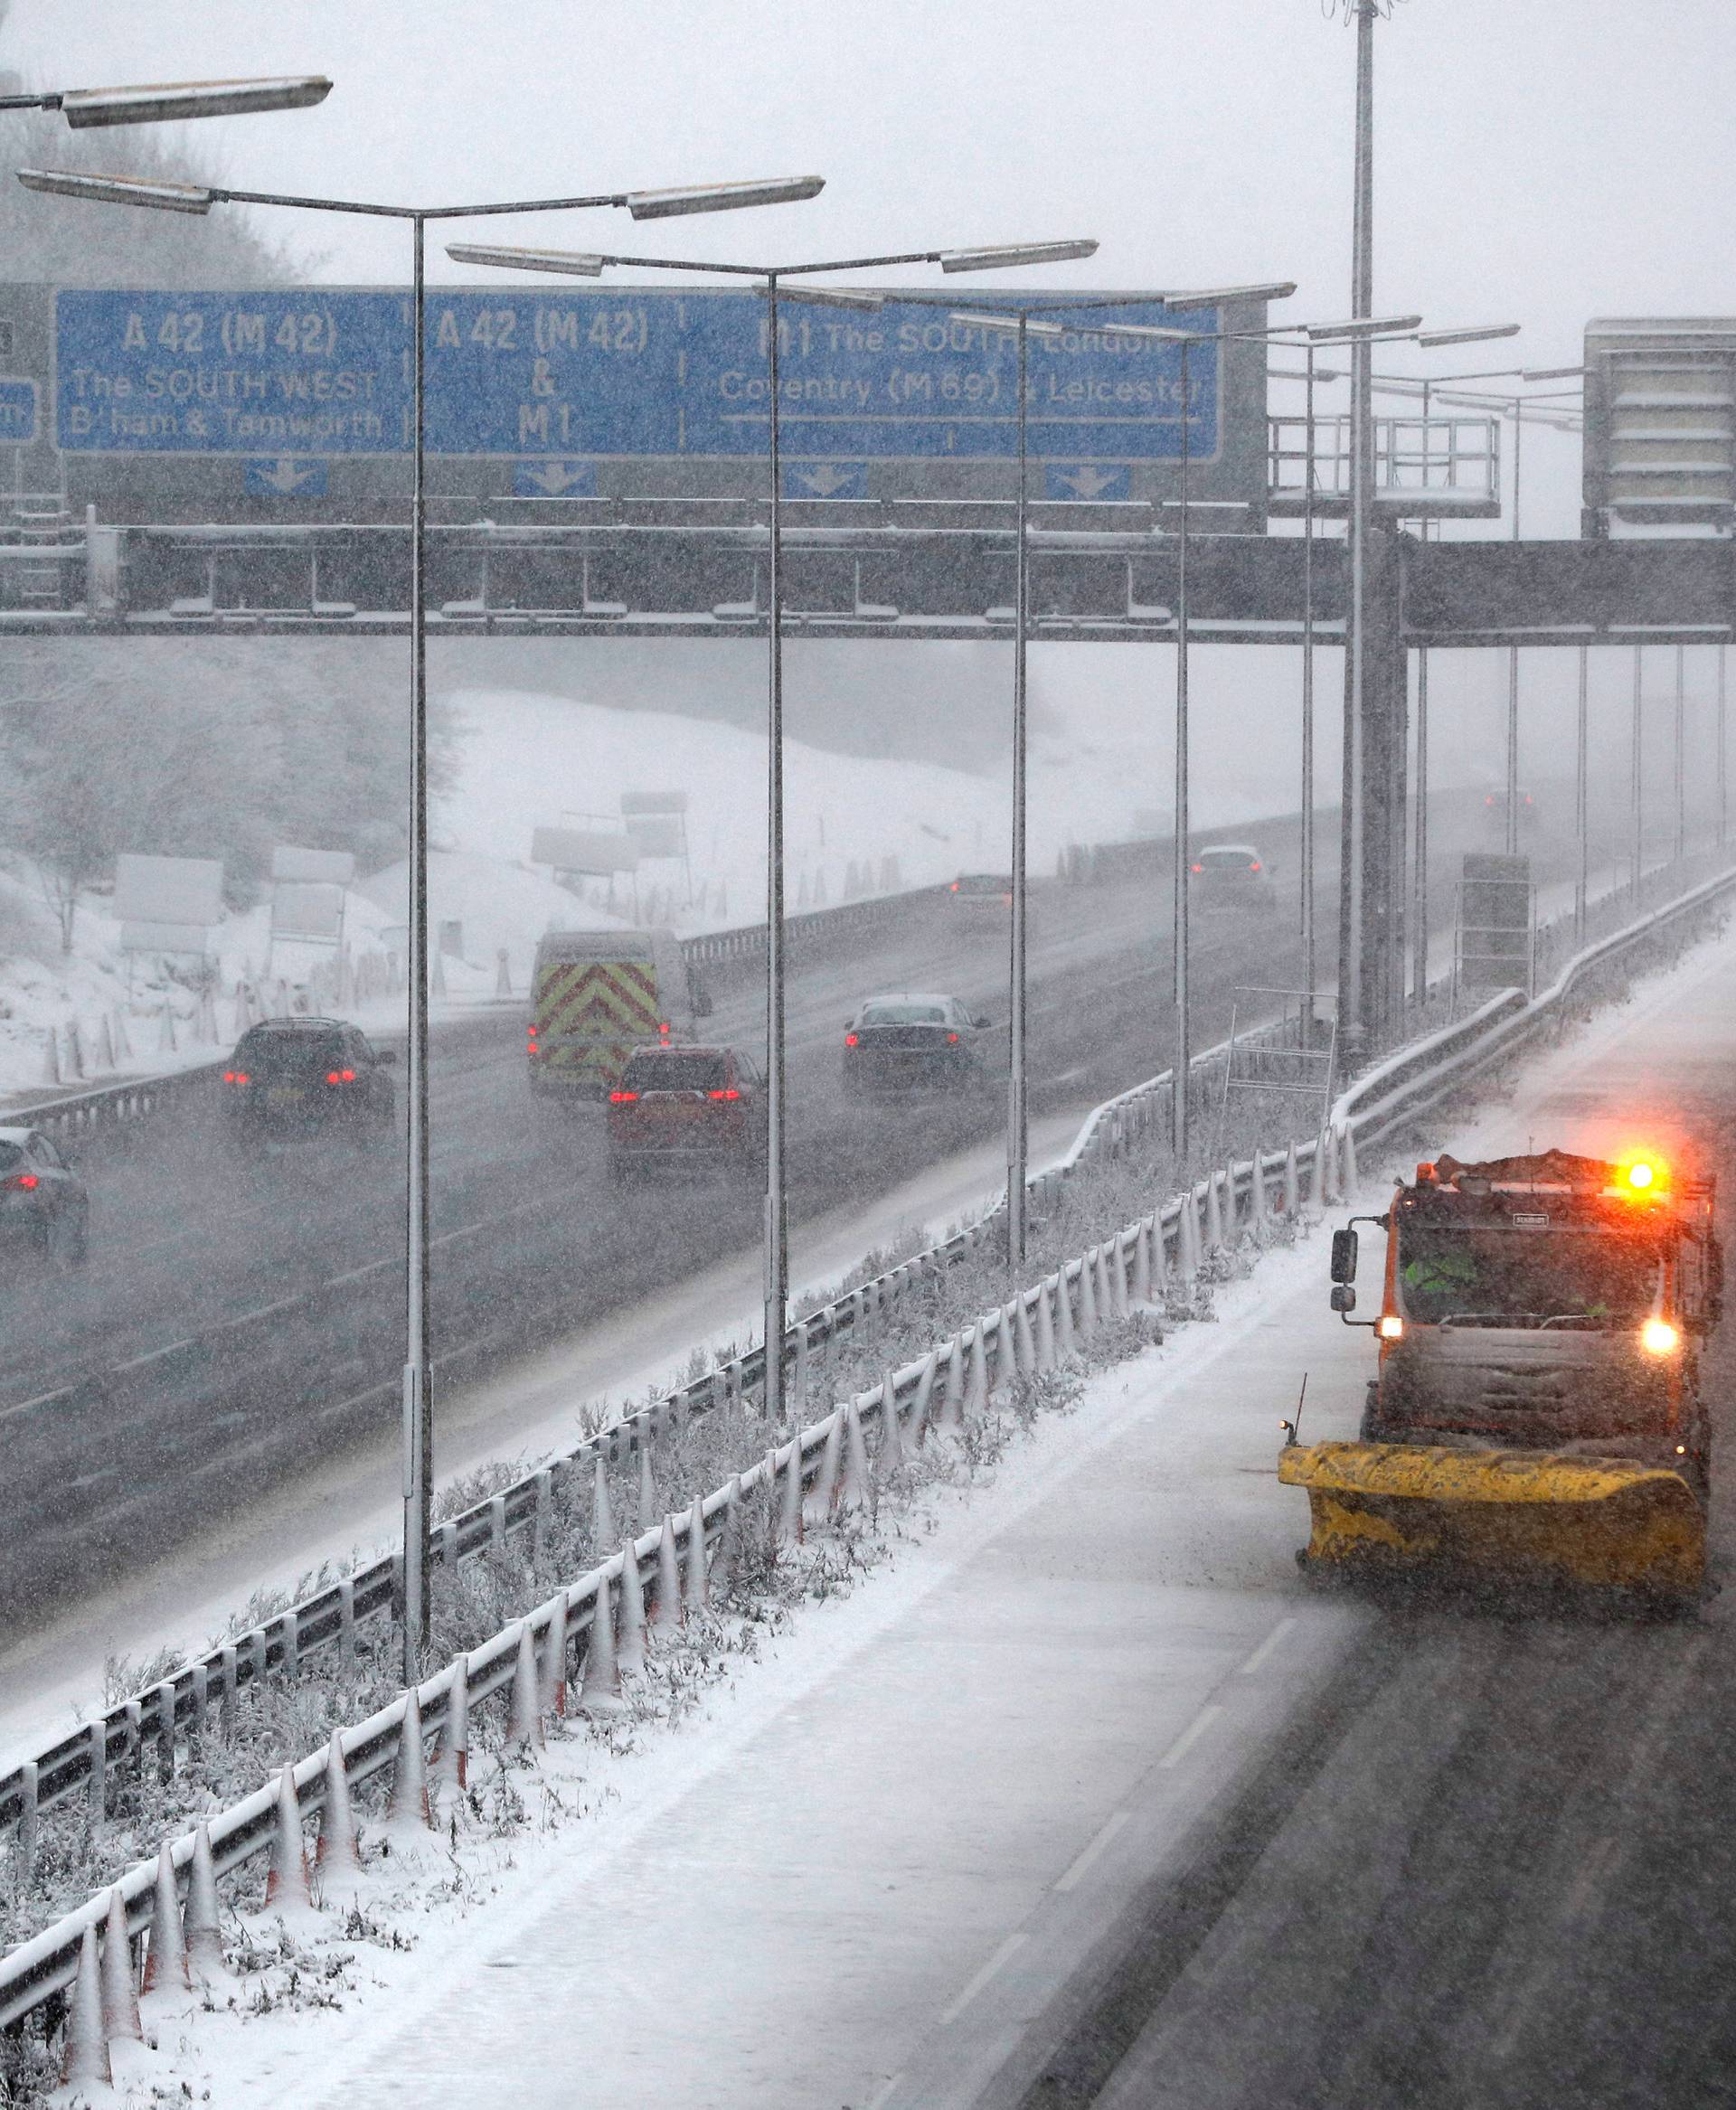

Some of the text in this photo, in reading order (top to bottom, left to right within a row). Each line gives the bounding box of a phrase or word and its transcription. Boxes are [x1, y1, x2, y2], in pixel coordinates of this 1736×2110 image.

[826, 323, 884, 353] The
[71, 367, 379, 400] The SOUTH WEST
[531, 357, 555, 397] &
[721, 371, 872, 406] Coventry
[1049, 371, 1203, 404] Leicester
[185, 408, 209, 436] &
[224, 407, 383, 438] Tamworth
